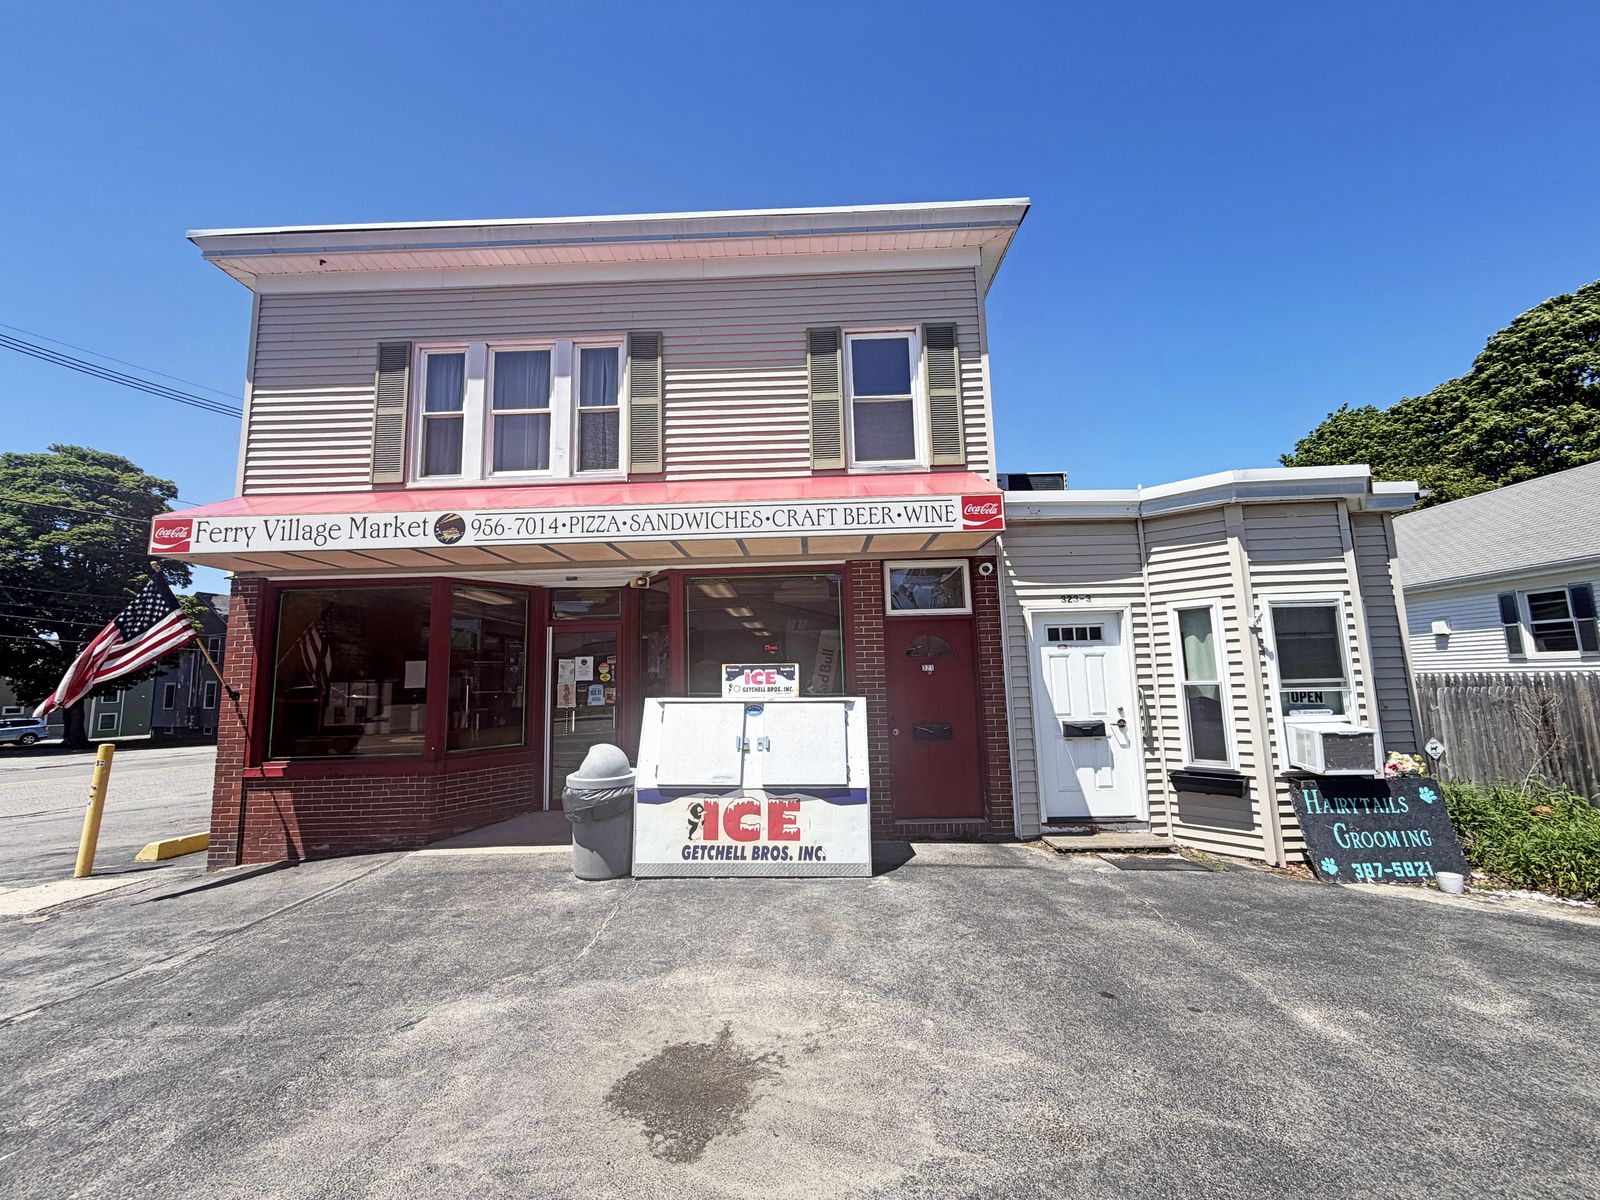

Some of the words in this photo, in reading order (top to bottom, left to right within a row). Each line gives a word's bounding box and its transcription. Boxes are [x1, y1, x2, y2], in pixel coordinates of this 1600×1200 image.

[471, 516, 559, 537] 956-7014
[569, 515, 620, 534] PIZZA
[629, 510, 763, 532] SANDWICHES
[772, 507, 838, 528] CRAFT
[843, 505, 896, 526] BEER
[903, 504, 957, 524] WINE
[194, 520, 255, 548] Ferry
[263, 518, 341, 547] Village
[349, 516, 429, 540] Market
[744, 670, 777, 685] ICE
[1291, 691, 1323, 703] OPEN
[702, 797, 801, 842] ICE
[681, 845, 747, 862] GETCHELL
[751, 845, 794, 862] BROS.
[797, 845, 827, 862] INC.
[1351, 861, 1435, 880] 387-5821
